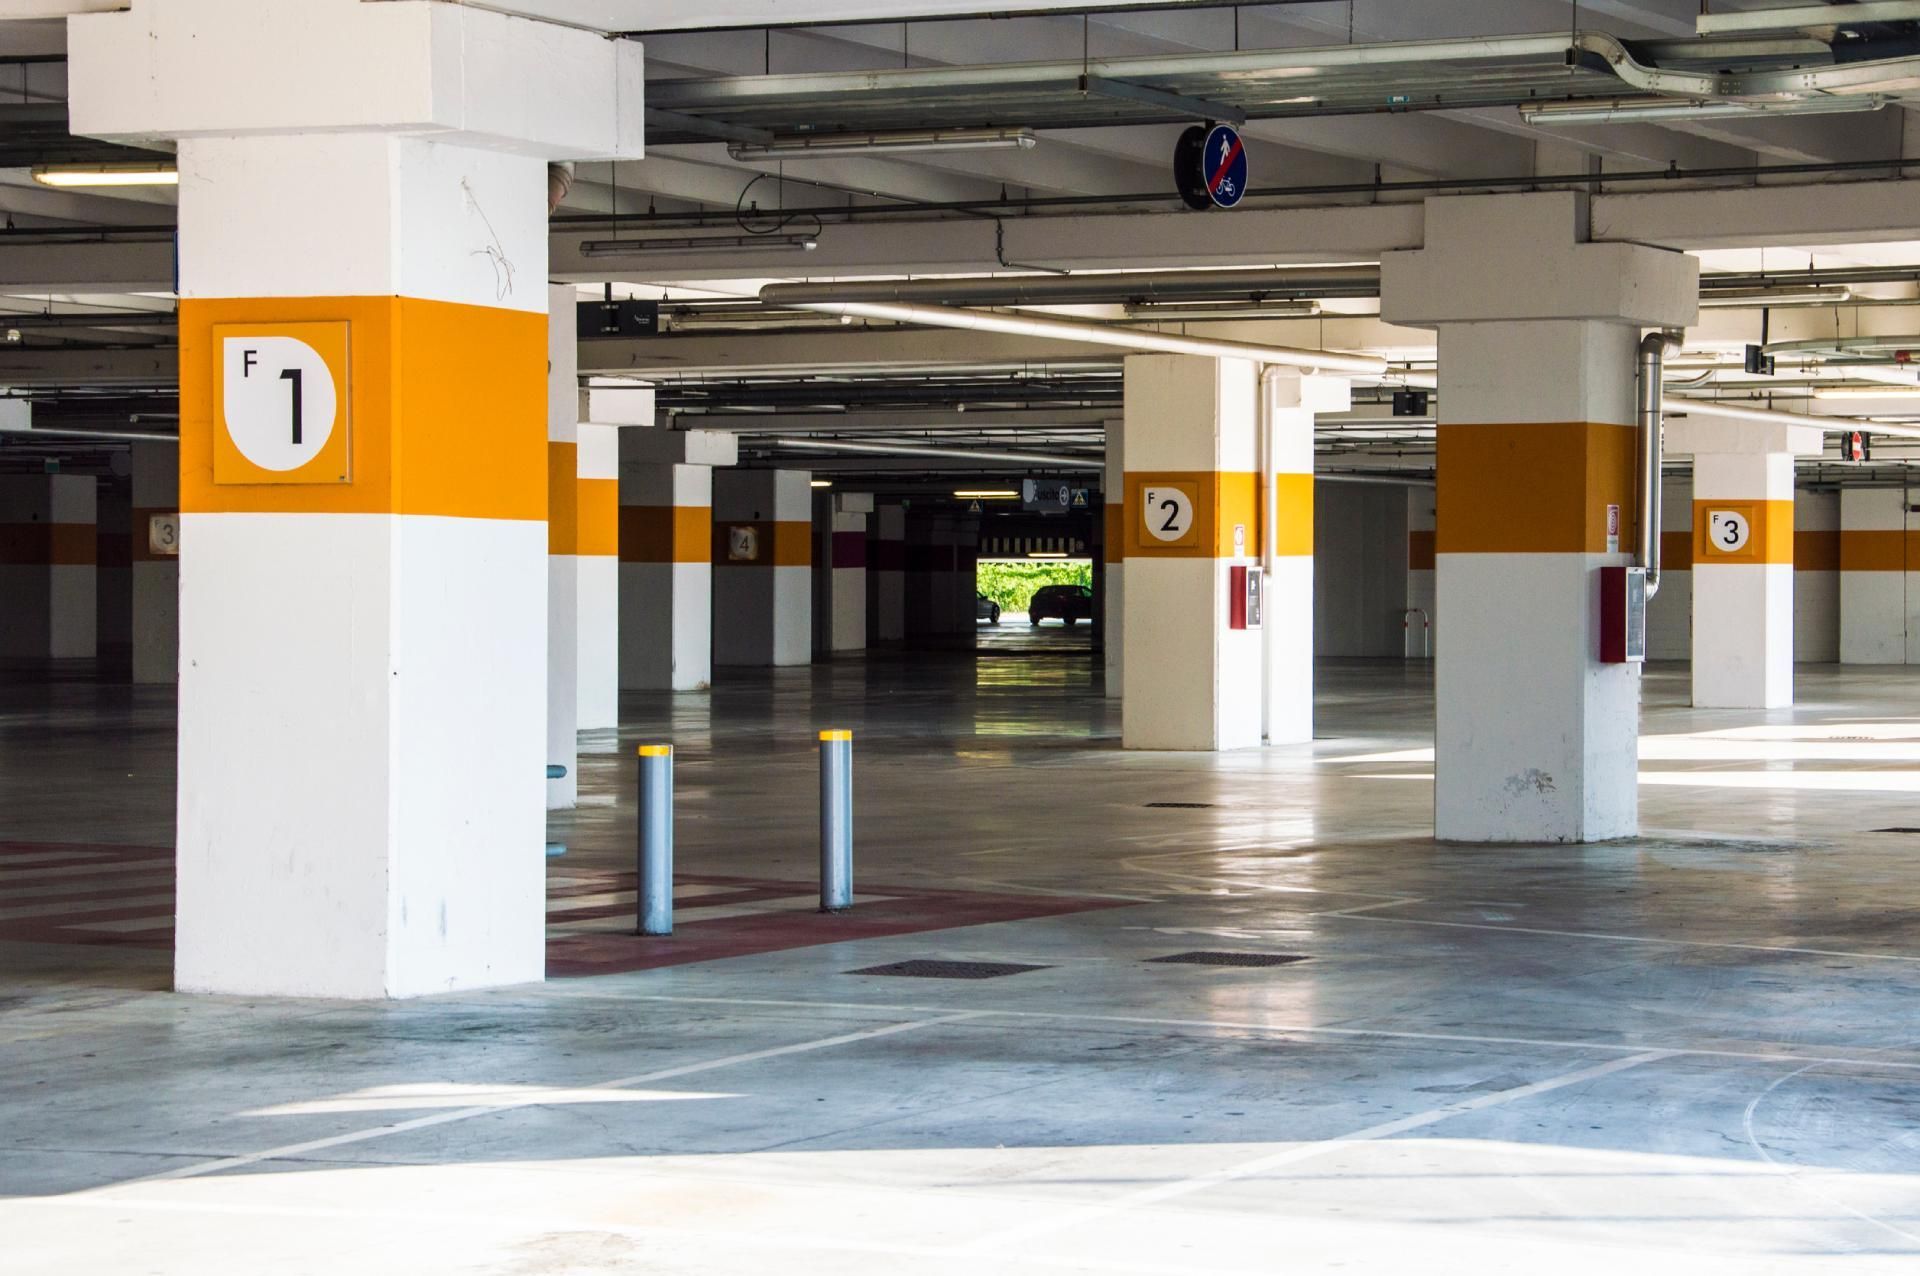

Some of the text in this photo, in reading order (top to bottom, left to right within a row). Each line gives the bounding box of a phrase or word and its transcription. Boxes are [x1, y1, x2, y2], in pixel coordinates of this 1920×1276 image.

[244, 350, 302, 444] F 1
[1148, 492, 1179, 531] F 2
[162, 523, 174, 545] 3
[739, 535, 750, 552] 4
[1713, 514, 1739, 545] F 3
